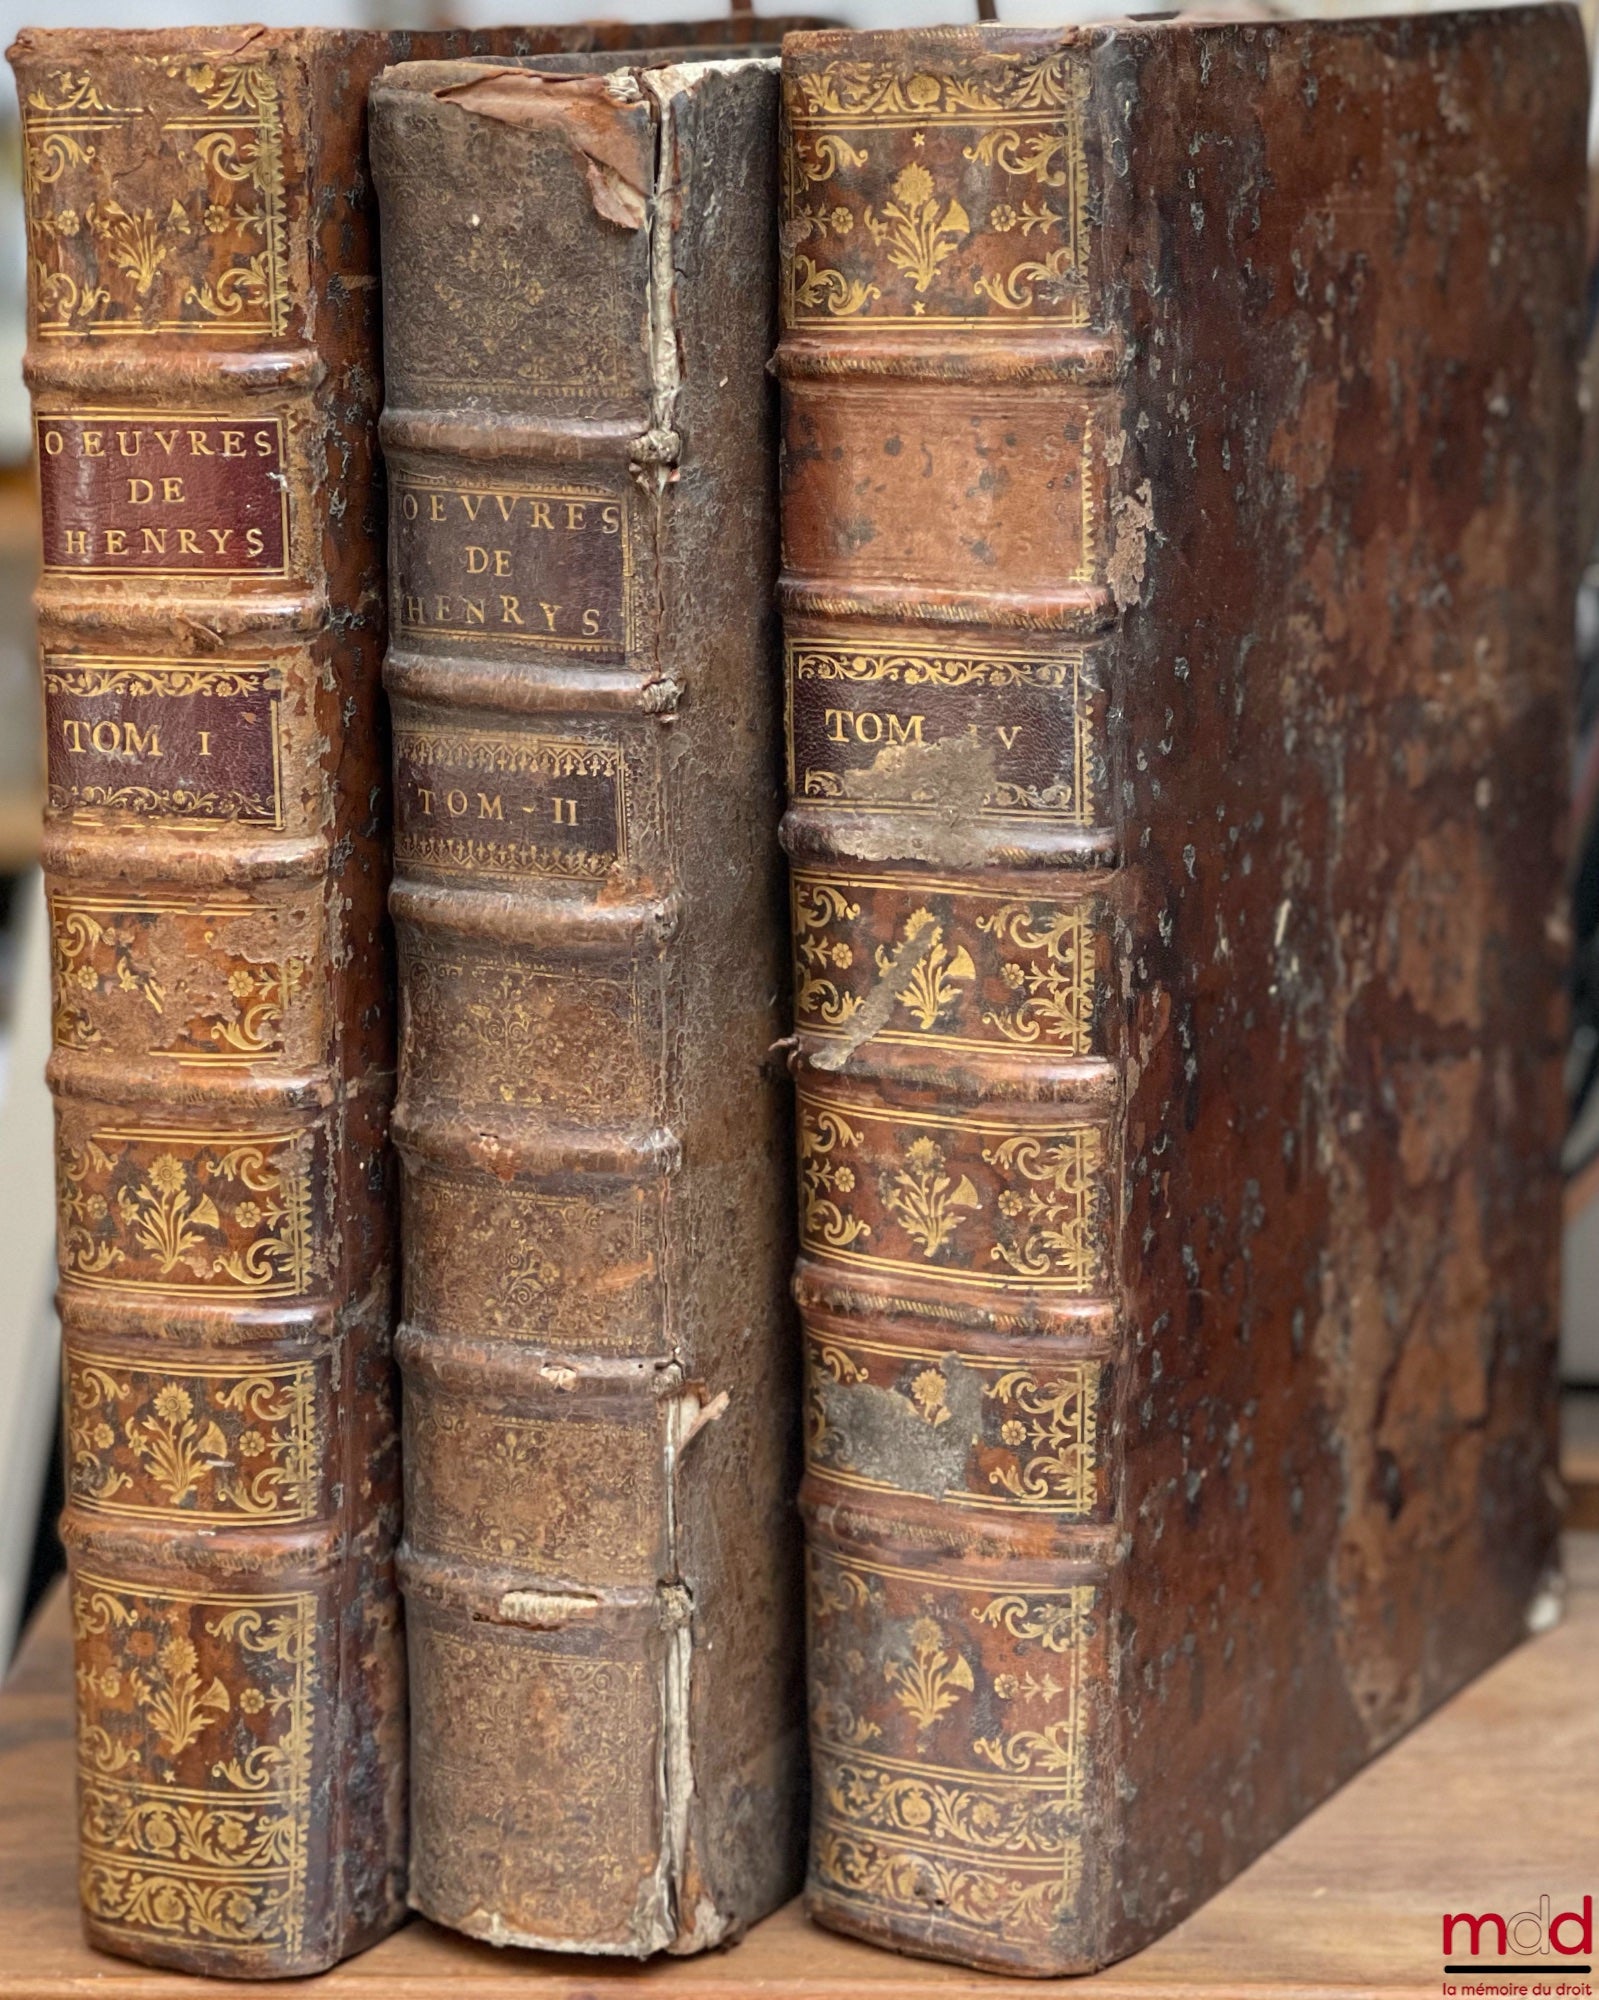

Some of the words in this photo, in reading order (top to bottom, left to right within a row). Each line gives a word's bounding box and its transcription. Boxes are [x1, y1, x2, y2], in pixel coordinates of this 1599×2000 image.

[44, 429, 274, 458] OEUVRES
[128, 477, 185, 504] DE
[402, 493, 620, 535] OEVVRES
[65, 527, 265, 558] HENRYS
[466, 546, 513, 577] DE
[406, 595, 600, 636] HENRYS
[63, 719, 163, 757] TOM
[199, 731, 212, 755] I
[825, 708, 925, 746] TOM
[417, 788, 505, 821] TOM
[551, 797, 579, 827] II
